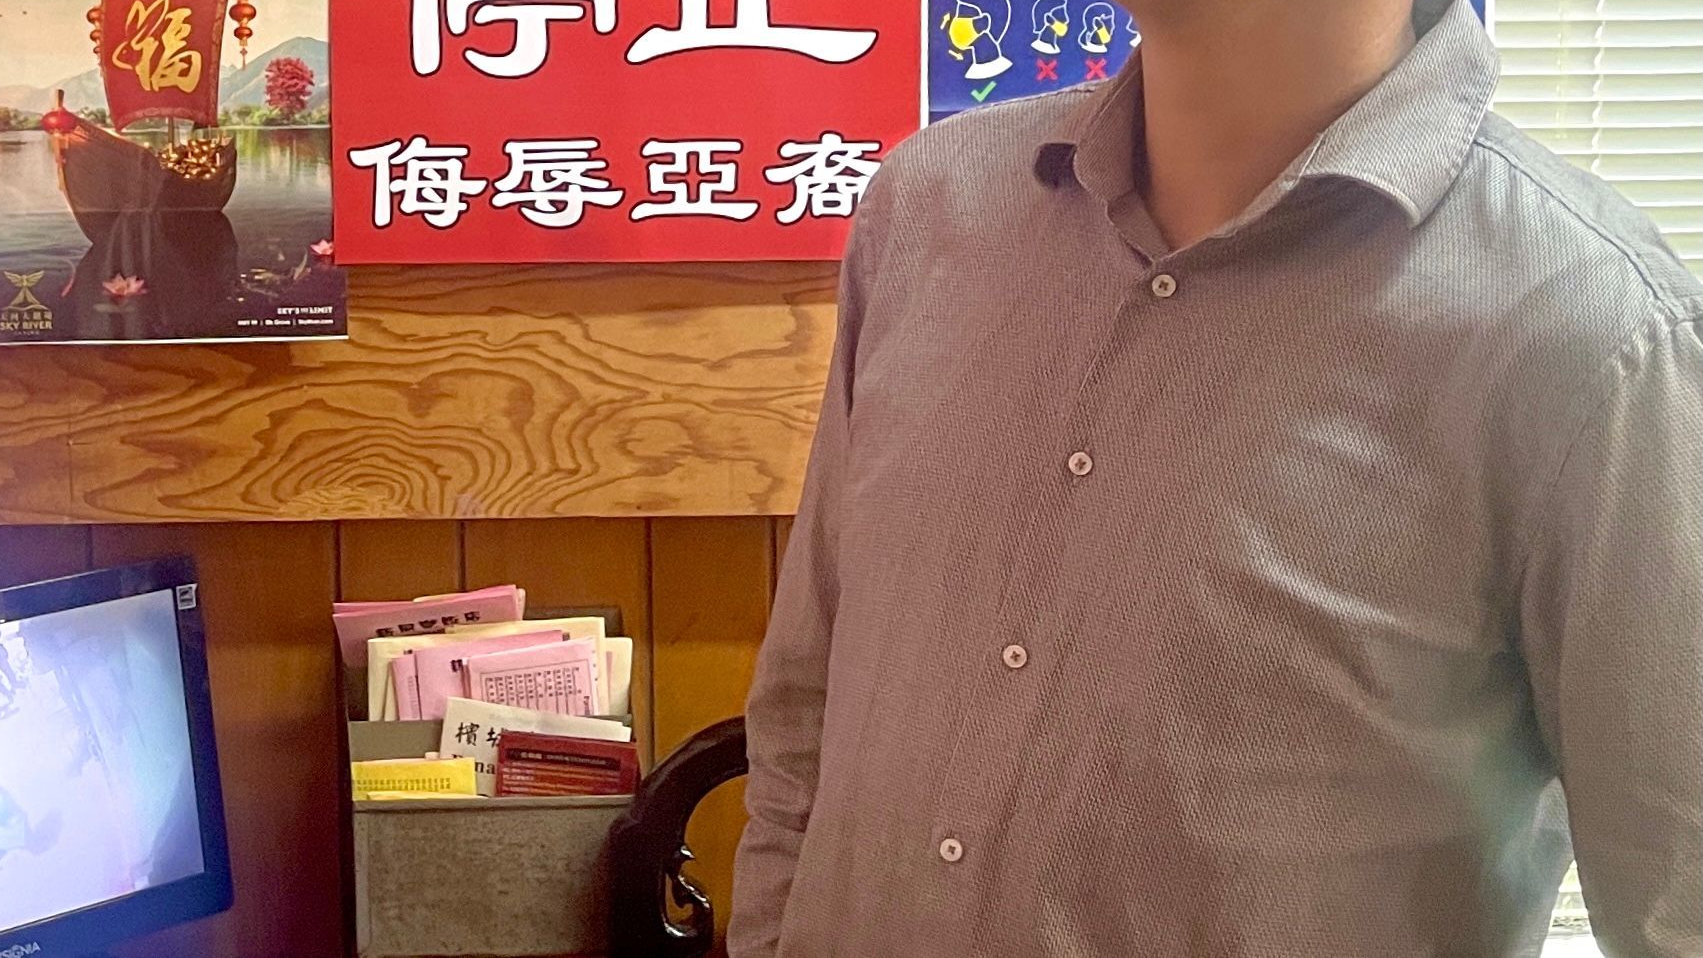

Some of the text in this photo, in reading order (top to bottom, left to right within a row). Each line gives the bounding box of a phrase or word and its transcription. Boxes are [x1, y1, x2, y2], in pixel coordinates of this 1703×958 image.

[347, 131, 883, 230] 侮辱亞裔
[0, 320, 53, 331] SKY RIVER
